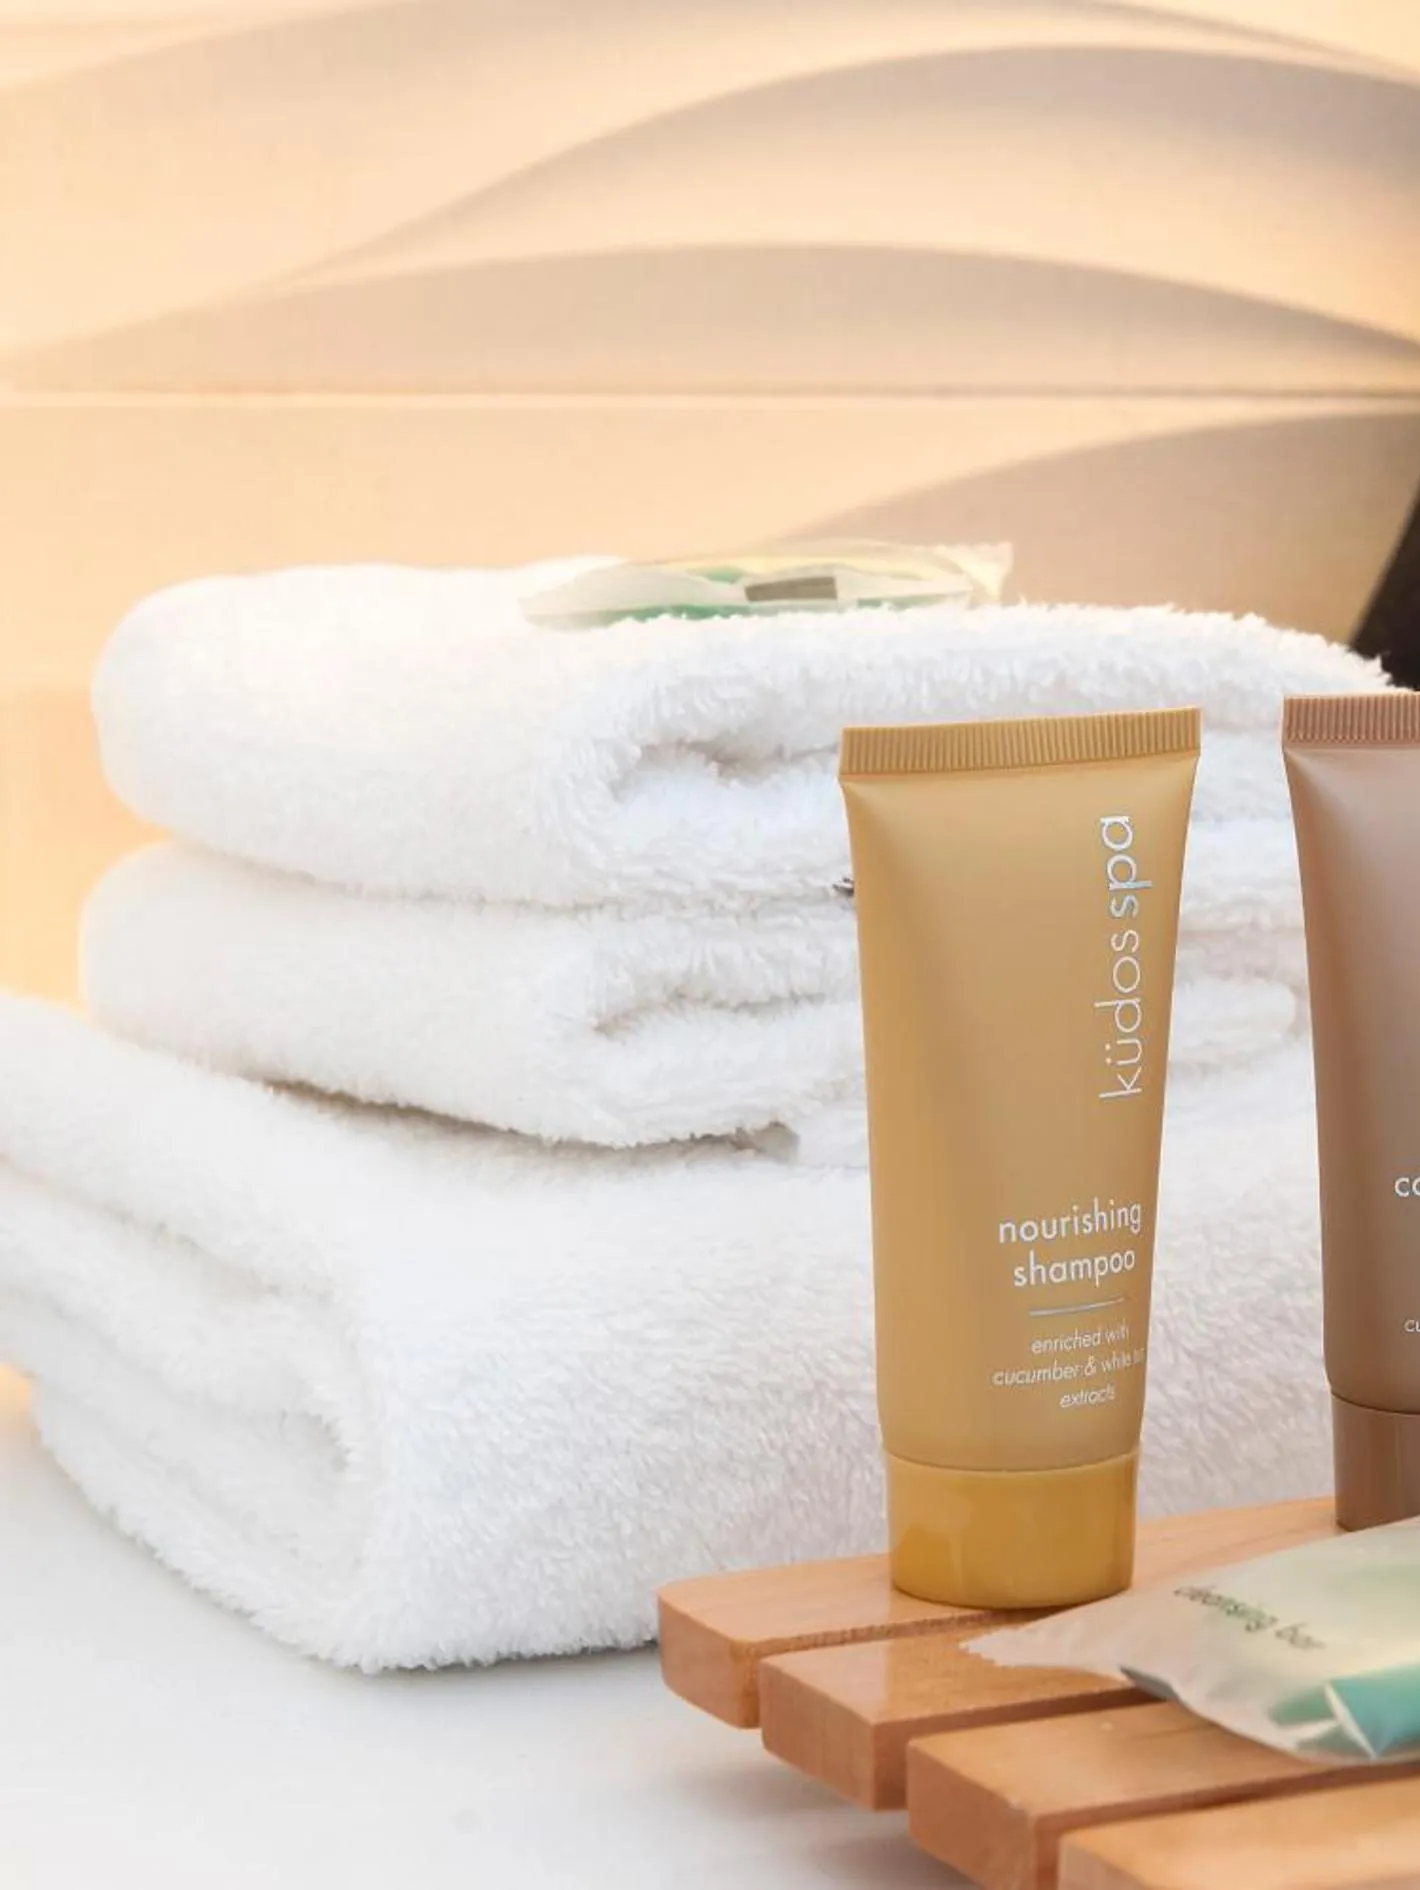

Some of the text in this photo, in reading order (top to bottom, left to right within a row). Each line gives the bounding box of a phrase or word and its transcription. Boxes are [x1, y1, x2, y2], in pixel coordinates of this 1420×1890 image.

[1094, 815, 1152, 1098] küdos spa
[999, 1197, 1142, 1243] nourishing
[1013, 1250, 1135, 1288] shampoo
[1031, 1327, 1100, 1354] enriched
[991, 1359, 1079, 1386] cucumber
[1084, 1355, 1098, 1377] &
[1059, 1382, 1117, 1408] extracts
